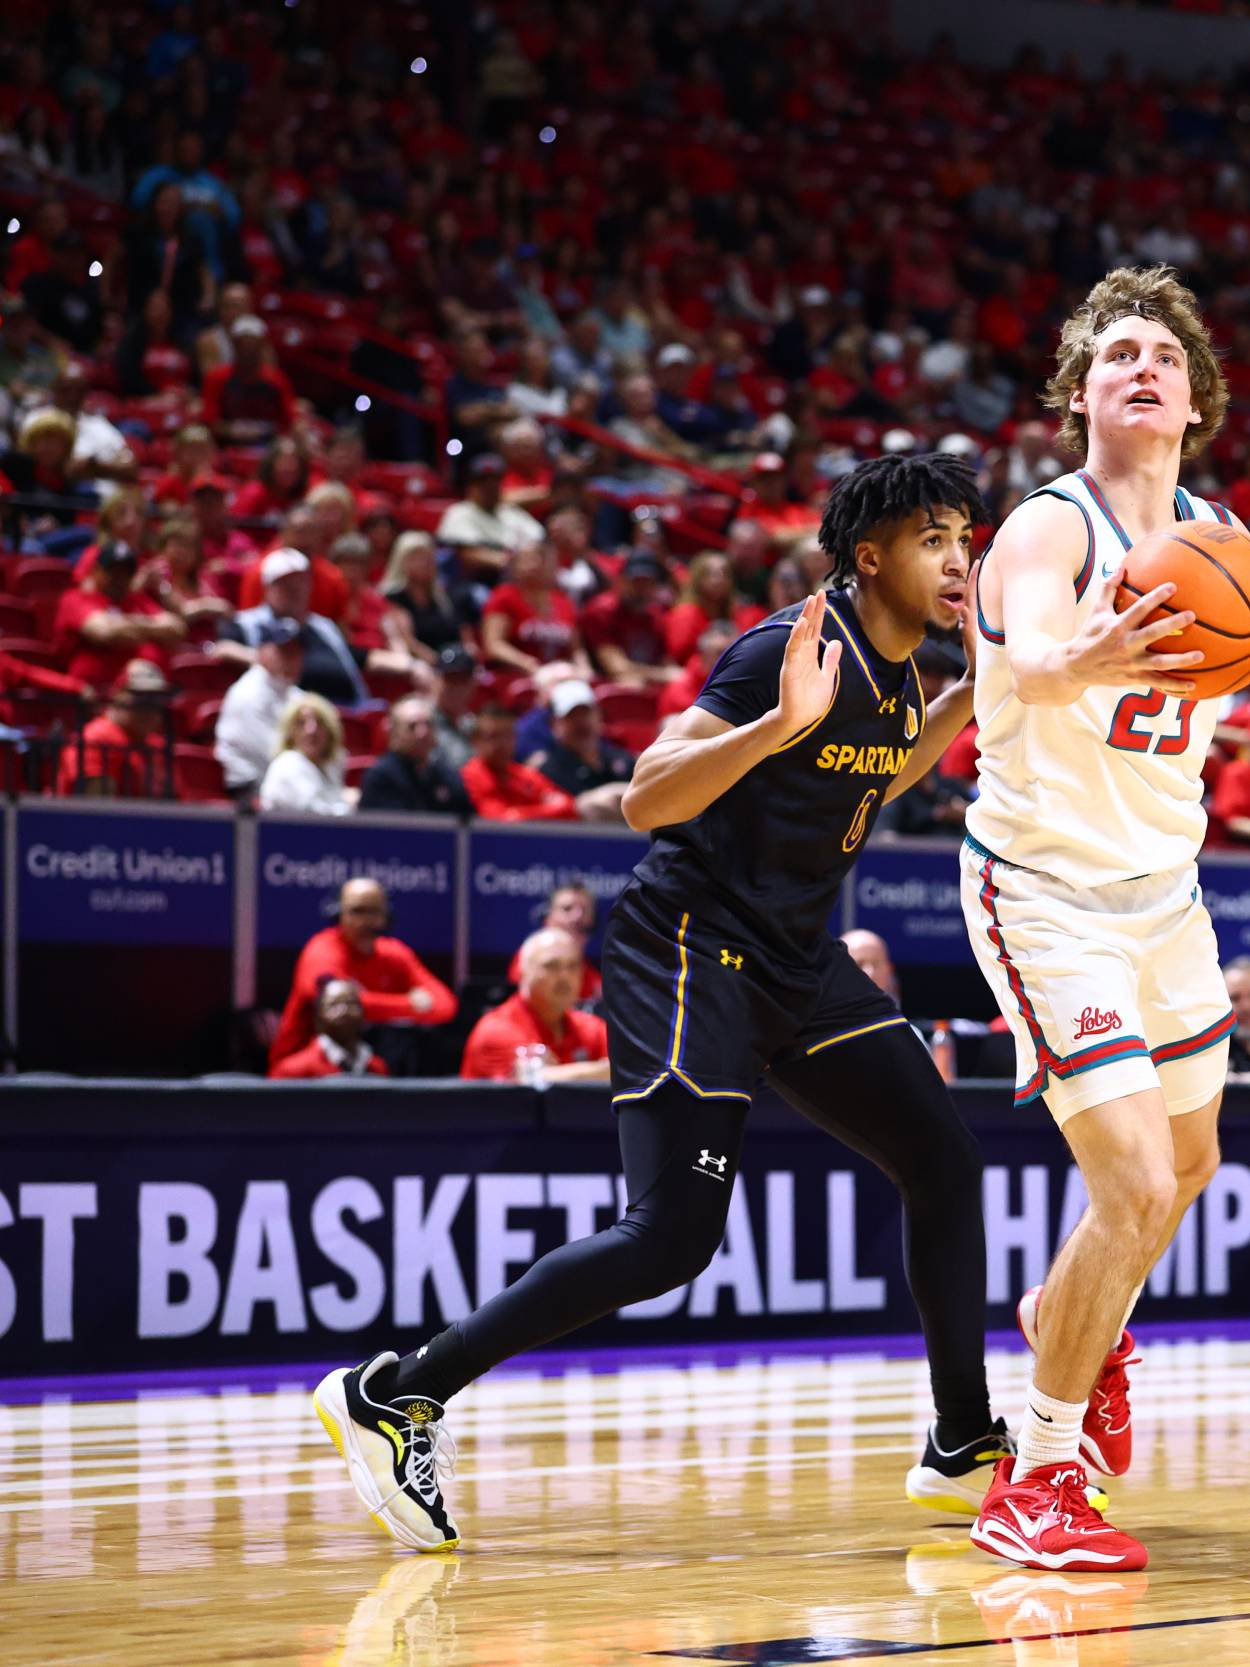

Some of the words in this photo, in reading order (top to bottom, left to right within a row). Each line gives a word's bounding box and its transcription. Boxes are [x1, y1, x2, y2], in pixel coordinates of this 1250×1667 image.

[27, 844, 119, 880] Credit
[1073, 1006, 1123, 1040] Lobos
[137, 1170, 887, 1339] BASKETALL
